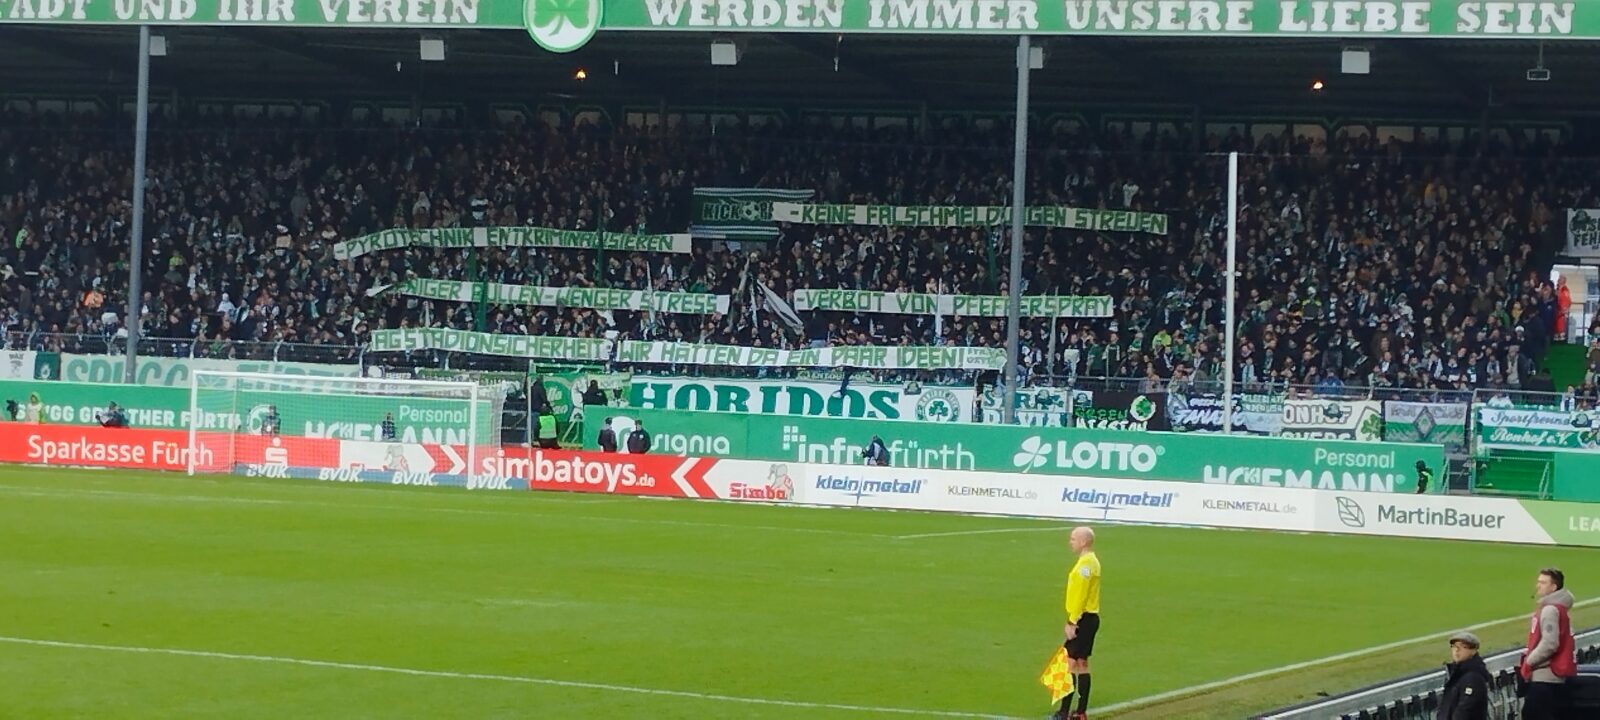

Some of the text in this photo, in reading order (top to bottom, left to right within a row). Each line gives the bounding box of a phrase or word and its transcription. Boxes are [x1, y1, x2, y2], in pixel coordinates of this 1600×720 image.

[114, 0, 196, 21] UND
[217, 0, 295, 22] IHR
[319, 0, 478, 24] VEREIN
[646, 0, 1574, 34] WERDEN IMMER UNSERE LIEBE SEIN
[865, 205, 1064, 227] FALSCHMELDUGEN
[1074, 210, 1167, 234] STREUEN
[618, 341, 651, 362] WIR
[747, 348, 780, 366] DA
[786, 349, 820, 366] EIN
[830, 346, 888, 368] PAAR
[630, 382, 900, 419] HORIDOS
[398, 404, 468, 424] Personal
[27, 434, 146, 465] Sparkasse
[1314, 447, 1395, 469] Personal
[729, 482, 786, 500] Simba
[1376, 504, 1506, 529] MartinBauer
